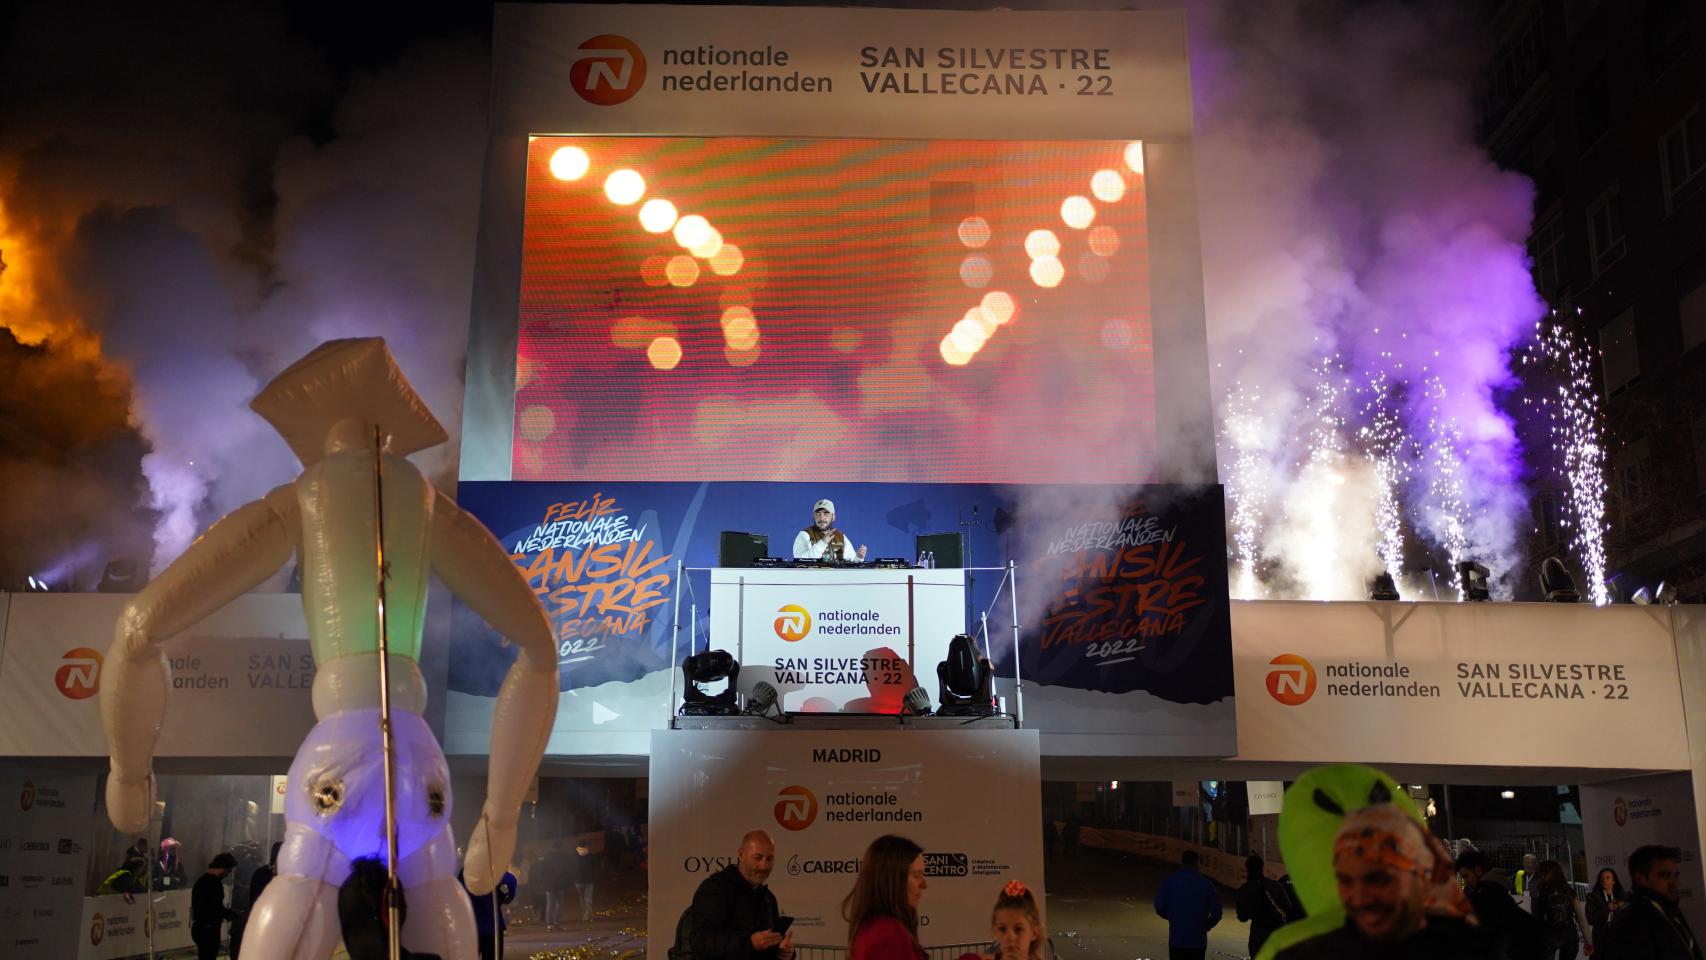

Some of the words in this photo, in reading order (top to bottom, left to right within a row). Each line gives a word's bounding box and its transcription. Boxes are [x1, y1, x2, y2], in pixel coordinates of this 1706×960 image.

[662, 44, 789, 67] nationale
[860, 46, 926, 69] SAN
[937, 48, 1111, 70] SILVESTRE
[662, 69, 833, 93] nederlanden
[860, 71, 1047, 96] VALLECANA
[1076, 74, 1114, 96] 22
[533, 515, 629, 538] NATIONALE
[1065, 516, 1160, 538] NATIONALE
[514, 523, 648, 554] NEDERLANDEN
[1047, 523, 1177, 555] NEDERLANDEN
[534, 574, 671, 617] STRE
[818, 609, 880, 621] nationale
[818, 623, 901, 635] nederlanden
[558, 638, 606, 656] 022
[1085, 638, 1145, 657] 2022
[248, 654, 292, 671] SAN
[774, 658, 808, 671] SAN
[813, 658, 901, 671] SILVESTRE
[1326, 661, 1410, 678] nationale
[774, 672, 869, 684] VALLECANA
[882, 673, 902, 685] 22
[1456, 662, 1500, 680] SAN
[1508, 663, 1626, 681] SILVESTRE
[173, 673, 229, 689] anden
[247, 673, 311, 689] VALLE
[1327, 680, 1441, 698] nederlanden
[1457, 682, 1585, 699] VALLECANA
[1603, 683, 1630, 700] 22
[812, 748, 882, 763] MADRID
[826, 791, 898, 806] nationale
[826, 807, 922, 823] nederlanden
[684, 857, 741, 873] OYSH
[803, 858, 862, 873] CABREI
[923, 855, 949, 865] SANI
[923, 865, 967, 876] CENTRO
